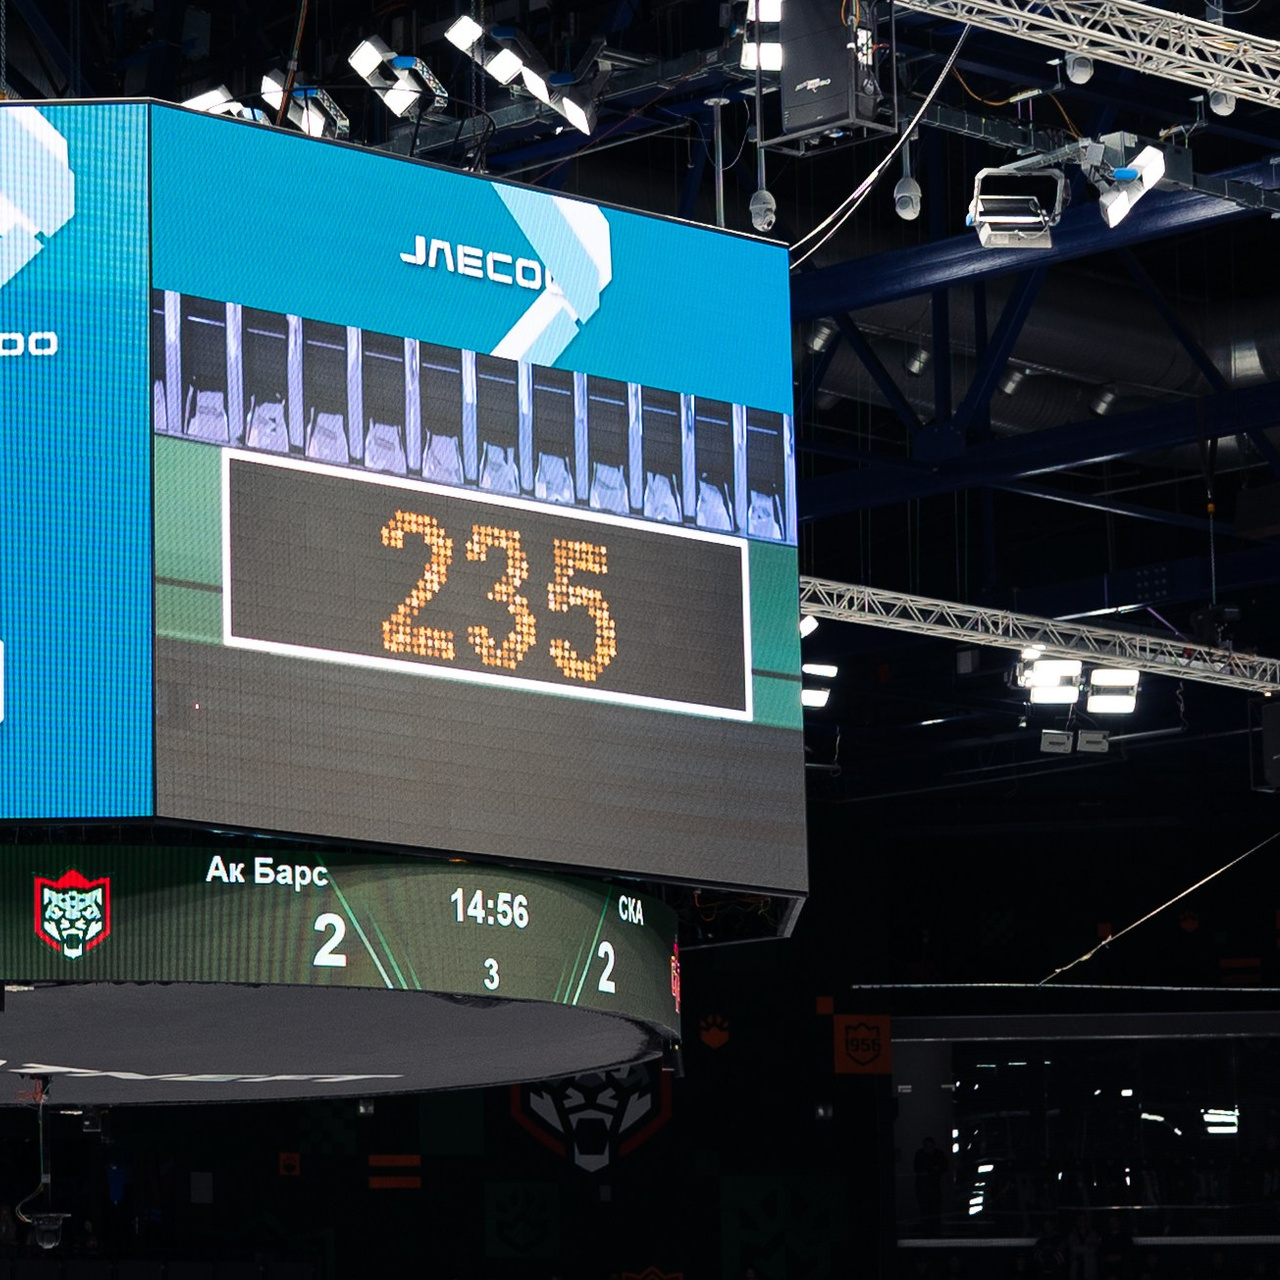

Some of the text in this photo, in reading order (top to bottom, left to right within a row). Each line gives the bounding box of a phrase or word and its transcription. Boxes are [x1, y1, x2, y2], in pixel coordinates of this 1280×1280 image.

[380, 509, 618, 683] 235
[205, 856, 329, 891] Ак Барс
[449, 888, 530, 931] 14:56
[618, 894, 645, 927] СКА
[312, 911, 348, 969] 2
[482, 957, 501, 991] 3
[596, 940, 616, 994] 2
